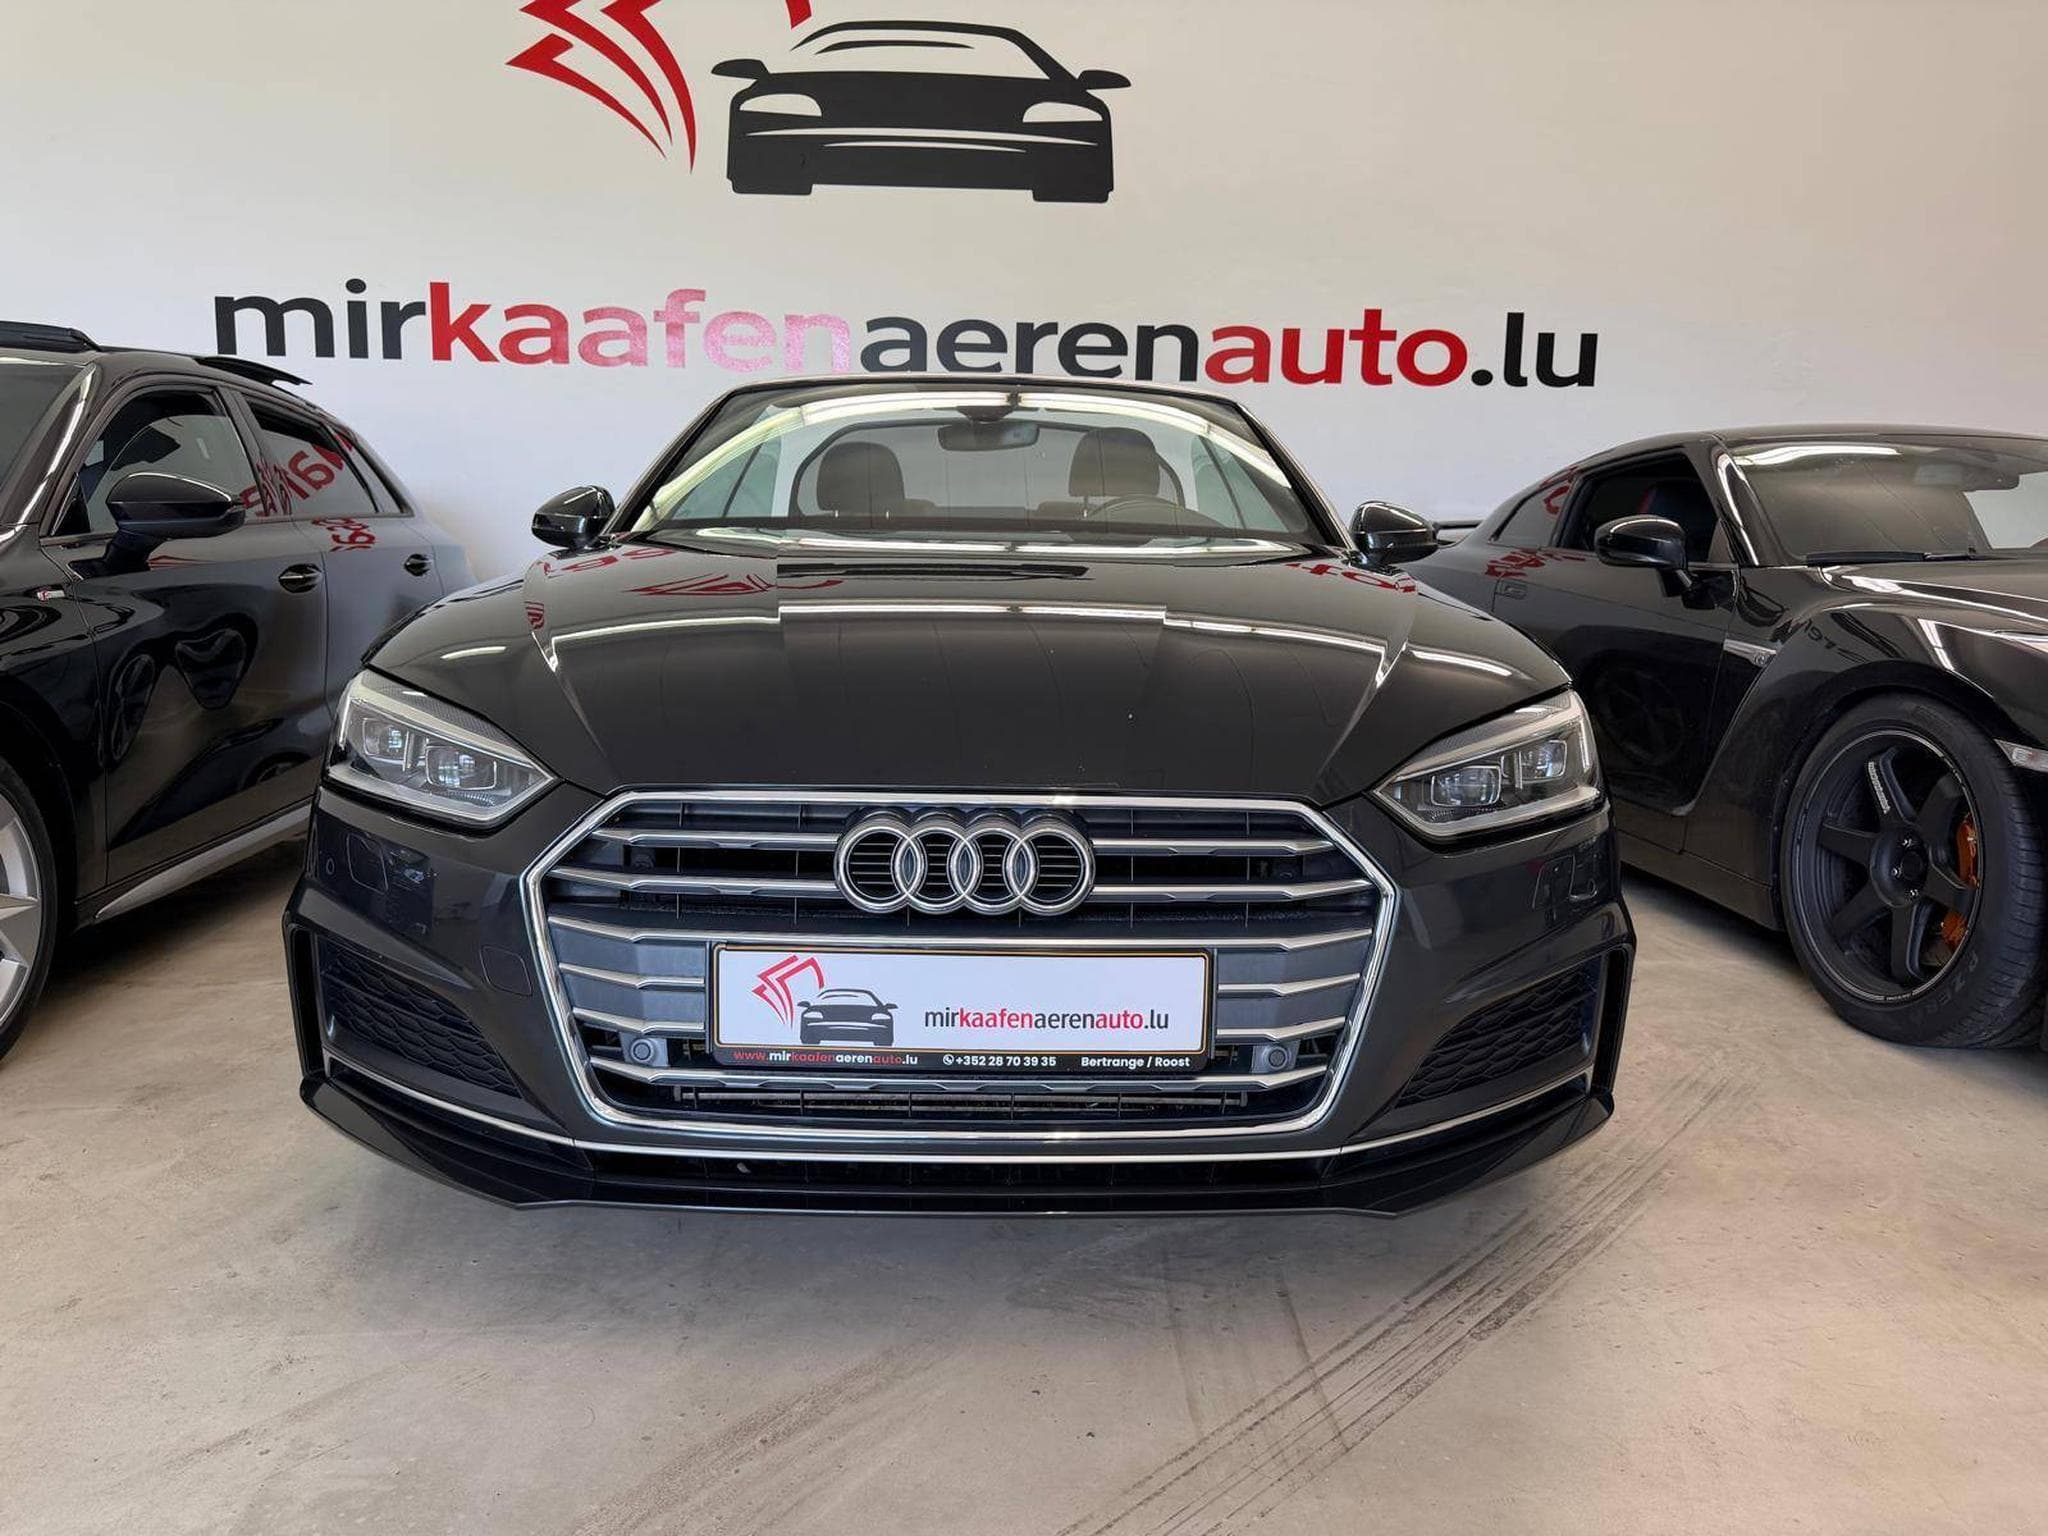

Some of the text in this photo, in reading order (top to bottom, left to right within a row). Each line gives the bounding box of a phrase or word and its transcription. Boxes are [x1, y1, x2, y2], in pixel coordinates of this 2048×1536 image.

[214, 278, 1598, 388] mirkaafenaerenauto.lu
[924, 1007, 1170, 1030] mirkaafenaerenauto.lu
[733, 1050, 918, 1065] www.mirkaafenaerenauto.lu
[955, 1056, 1057, 1067] +352 28 70 39 35
[1081, 1056, 1190, 1070] Bertrange / Roost
